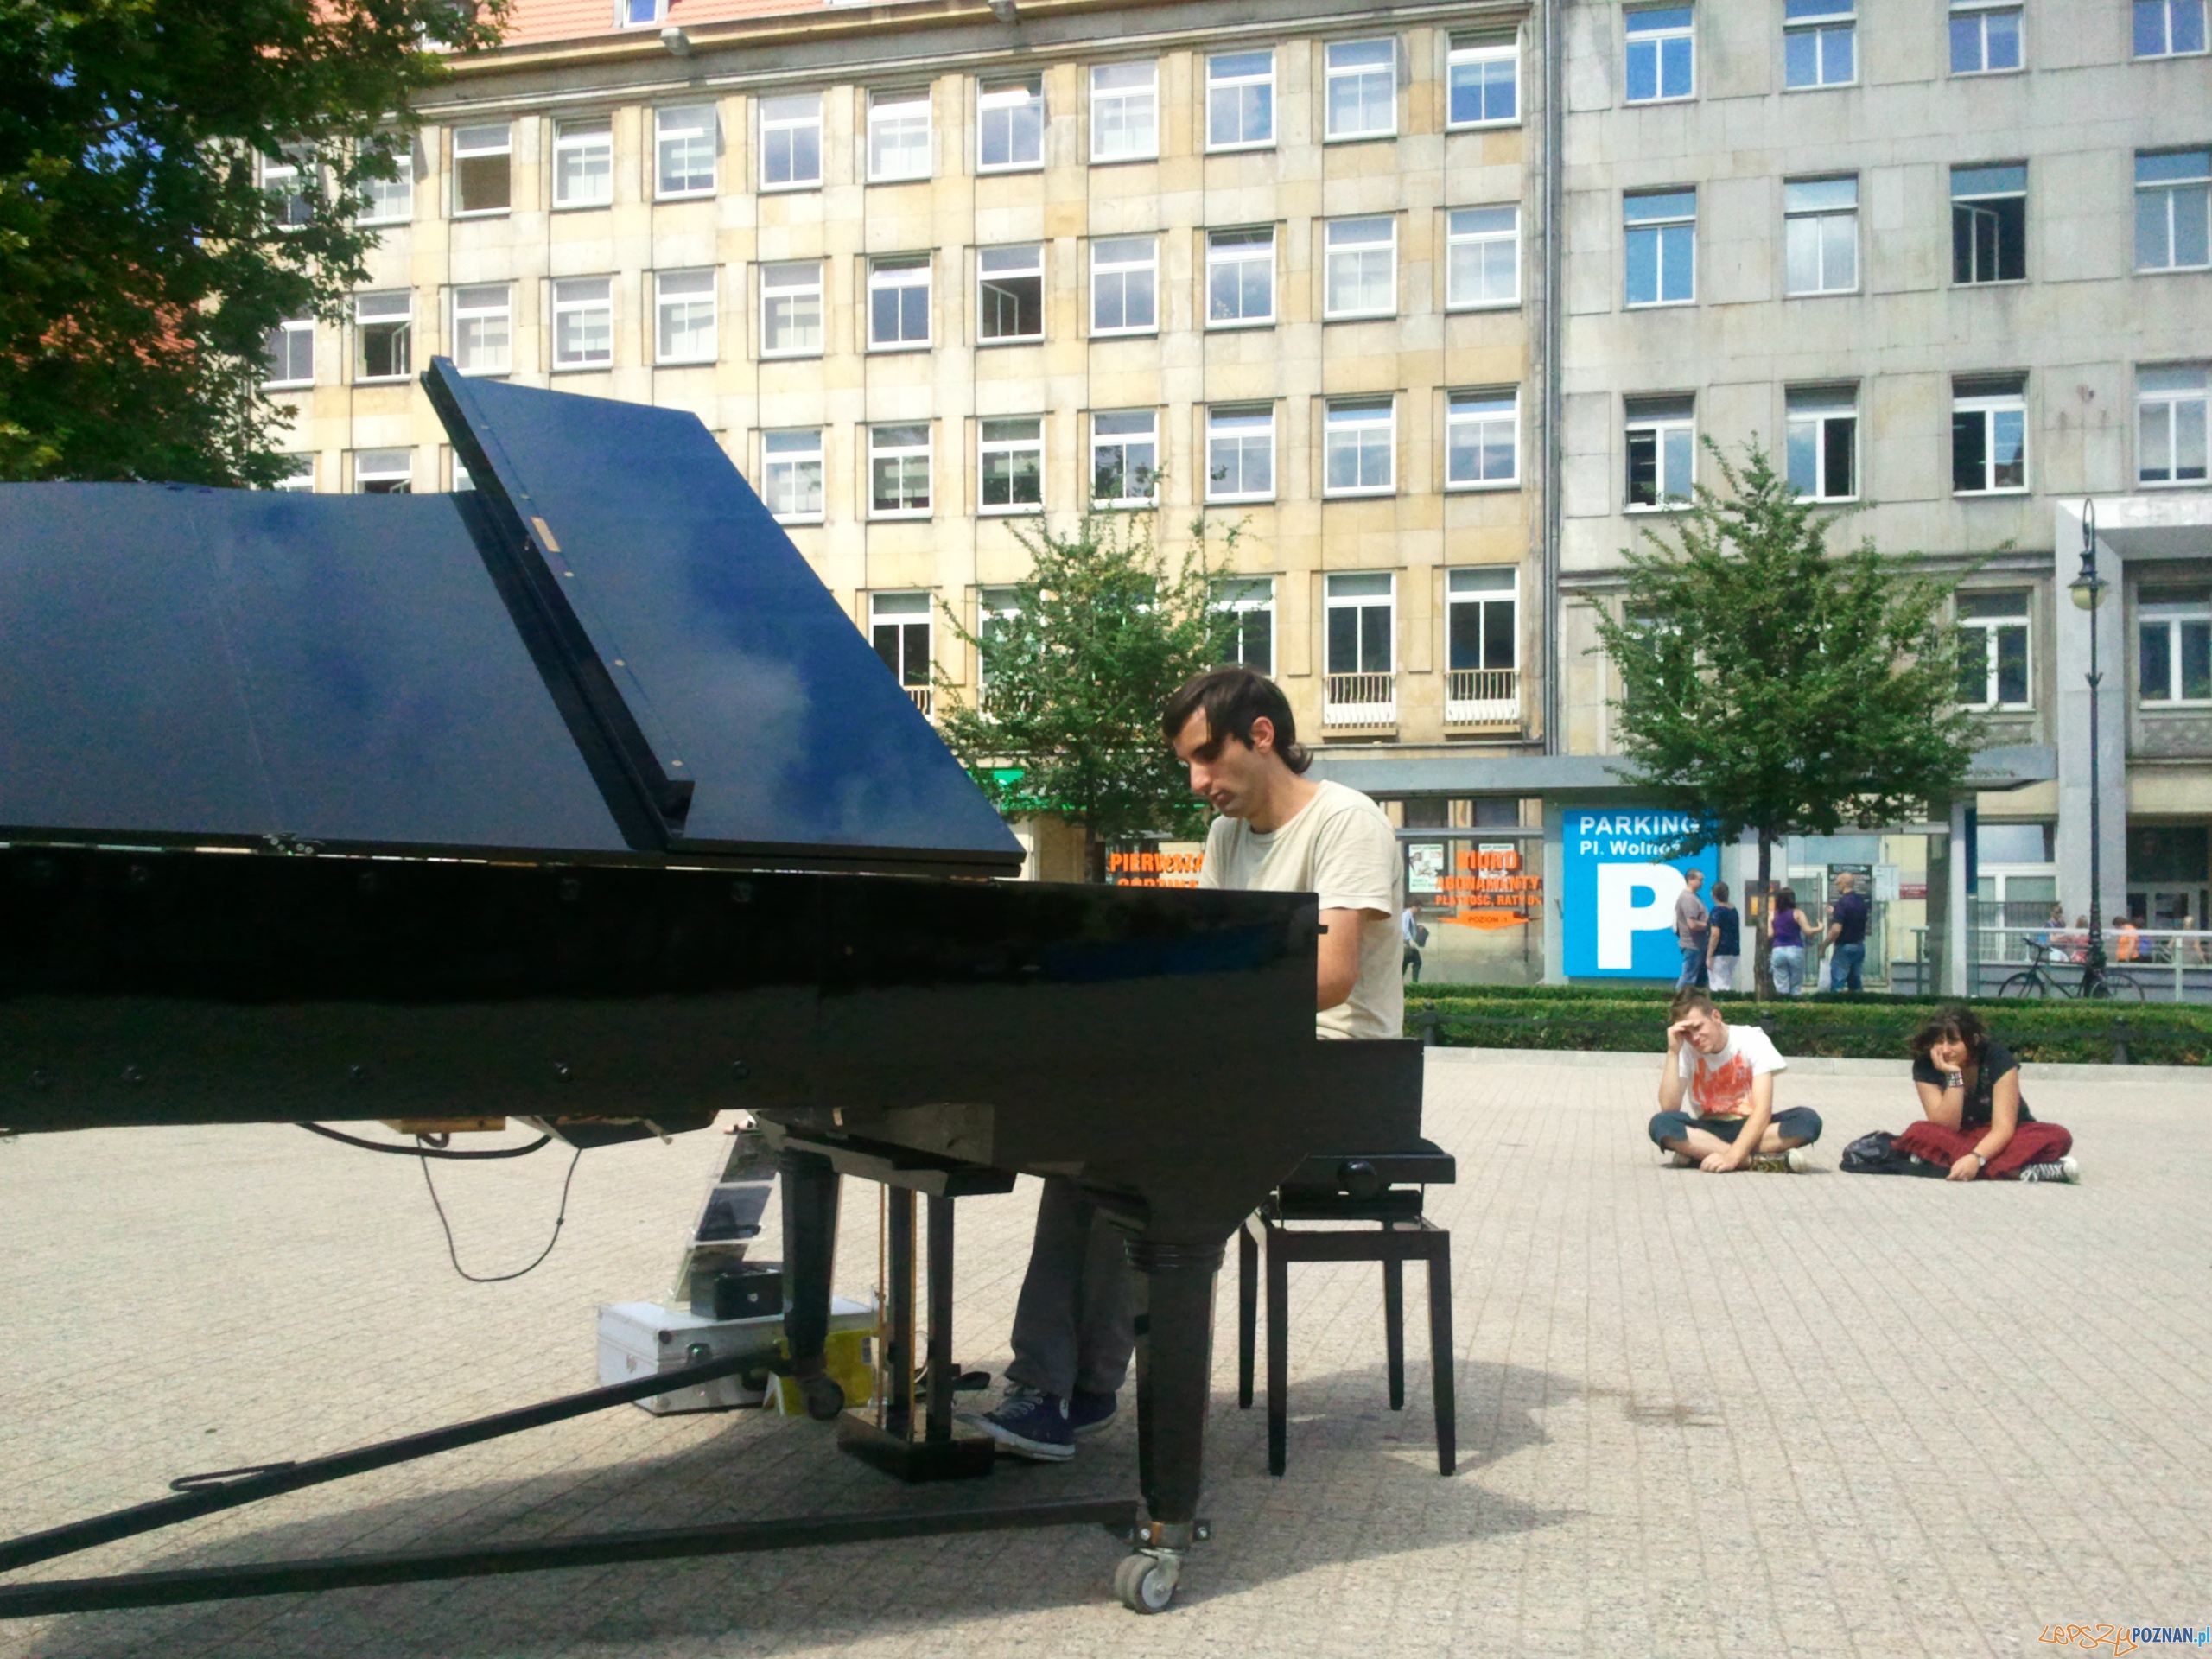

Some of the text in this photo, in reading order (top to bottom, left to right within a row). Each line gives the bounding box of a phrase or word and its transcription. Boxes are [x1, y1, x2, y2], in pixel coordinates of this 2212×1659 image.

[1580, 816, 1700, 836] PARKING
[1580, 840, 1605, 855] Pl.
[1456, 849, 1518, 870] BIURO
[1434, 875, 1541, 891] ABONAMENTY
[1597, 862, 1687, 969] P
